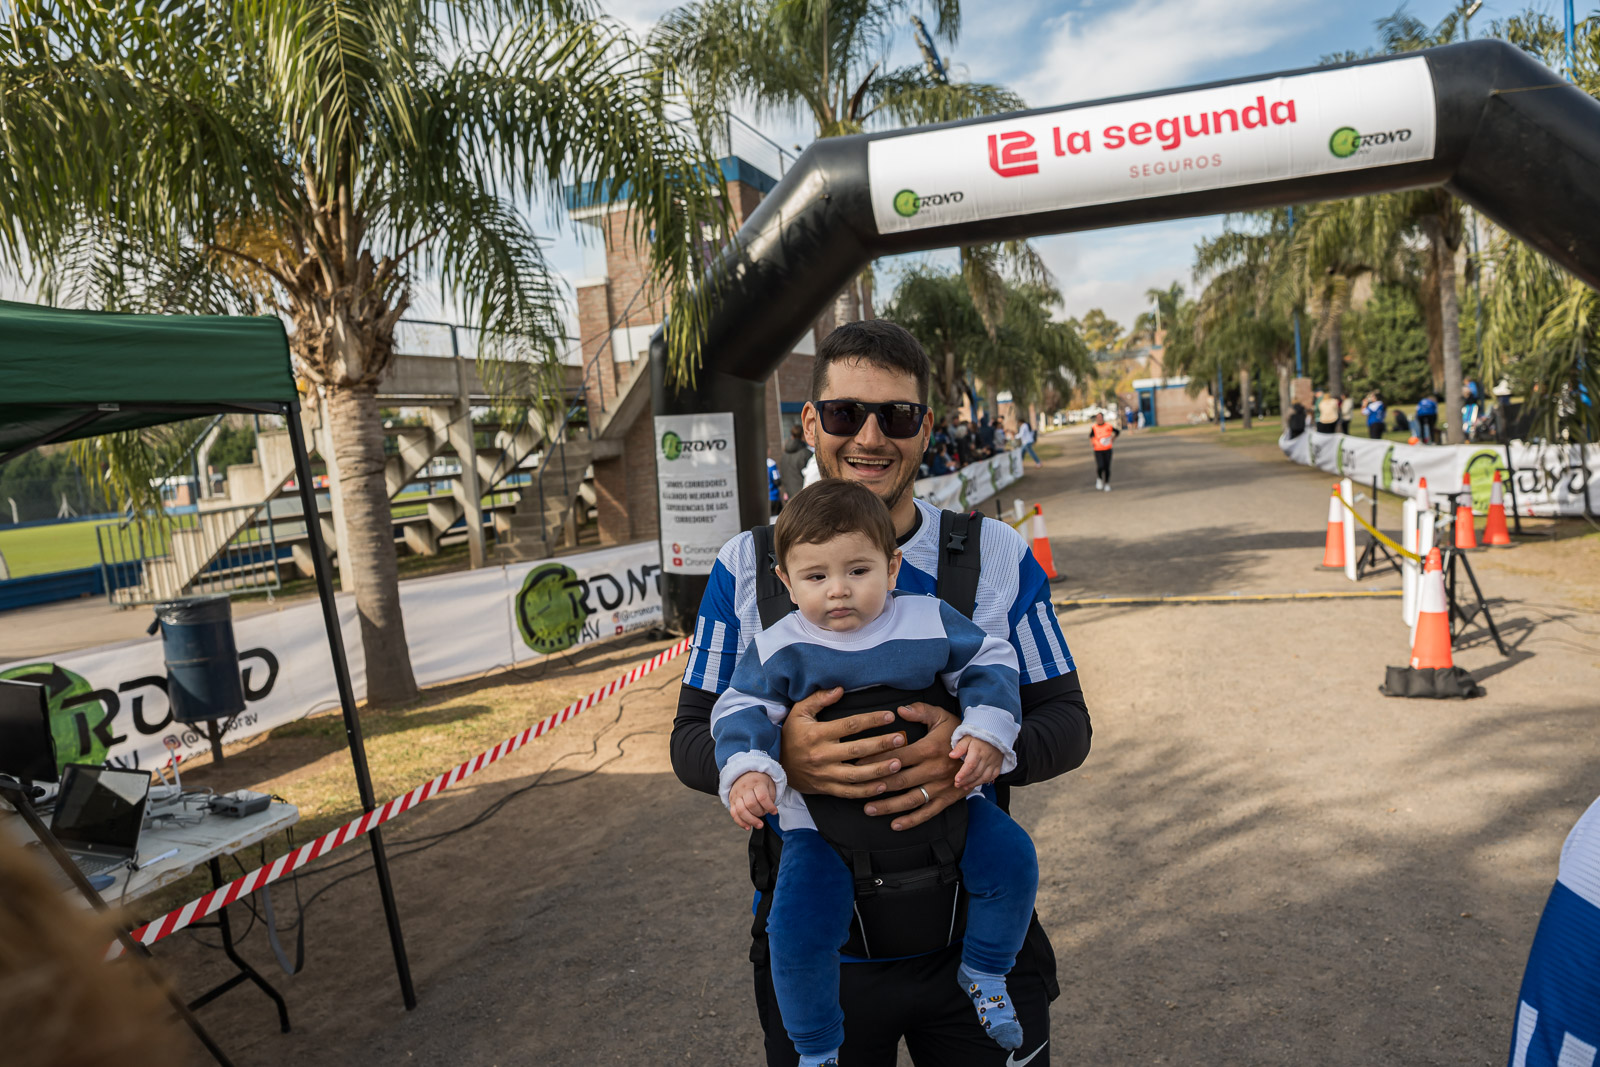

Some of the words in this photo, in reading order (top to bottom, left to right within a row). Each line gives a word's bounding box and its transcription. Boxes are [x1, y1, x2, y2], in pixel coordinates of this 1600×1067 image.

[1052, 126, 1092, 157] la
[1102, 95, 1297, 151] segunda
[1129, 153, 1223, 179] SEGUROS
[566, 618, 601, 647] RAV
